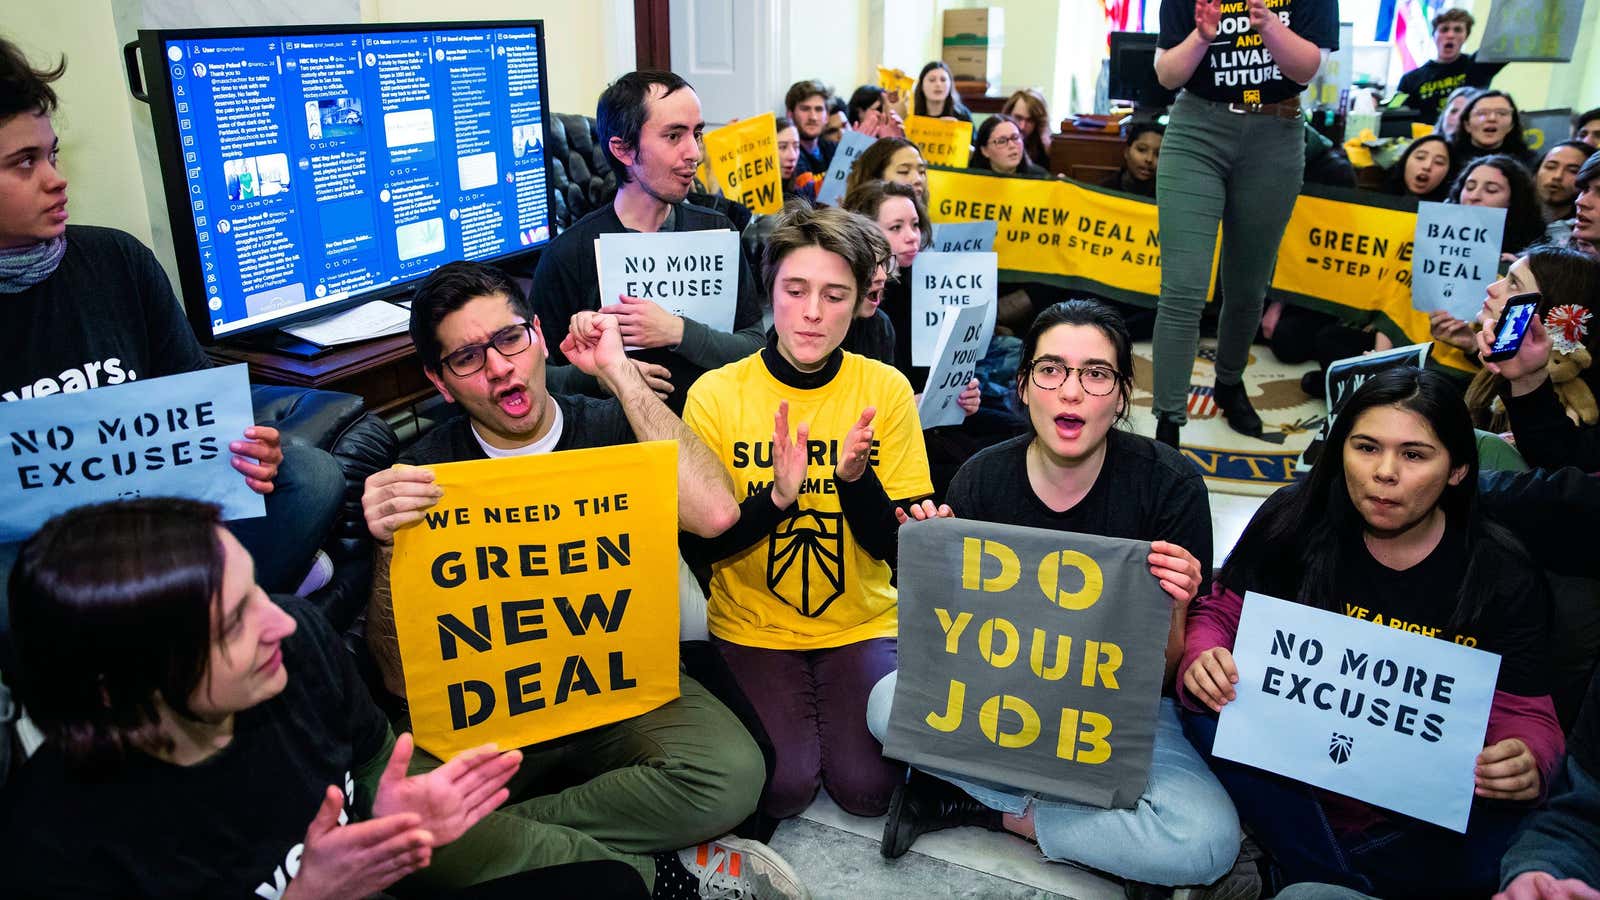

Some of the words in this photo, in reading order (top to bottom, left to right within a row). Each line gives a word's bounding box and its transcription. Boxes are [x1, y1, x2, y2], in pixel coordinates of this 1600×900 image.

[1216, 16, 1250, 36] OD
[1236, 34, 1262, 48] AND
[1220, 48, 1273, 68] LIVAB
[1214, 65, 1283, 86] FUTURE
[918, 142, 958, 155] REEN
[728, 156, 774, 188] GREEN
[737, 182, 776, 211] EW
[940, 199, 1013, 222] GREEN
[1022, 206, 1070, 226] NEW
[1078, 216, 1136, 243] DEAL
[1428, 224, 1488, 244] BACK
[942, 238, 984, 252] BACK
[1007, 230, 1031, 244] UP
[1038, 232, 1060, 248] OR
[1068, 235, 1114, 258] STEP
[1122, 250, 1161, 268] ASI
[1308, 228, 1389, 258] GREEN
[1439, 245, 1472, 258] THE
[625, 256, 656, 274] NO
[667, 254, 724, 272] MORE
[1423, 259, 1482, 281] DEAL
[626, 278, 722, 298] EXCUSES
[926, 274, 984, 290] BACK
[939, 295, 970, 306] THE
[940, 370, 974, 390] JOB
[10, 425, 75, 456] NO
[98, 401, 216, 444] MORE
[18, 436, 220, 490] EXCUSES
[733, 440, 881, 468] SURIE
[425, 508, 470, 530] WE
[484, 504, 561, 524] NEED
[574, 493, 629, 516] THE
[430, 533, 632, 588] GREEN
[961, 536, 1104, 611] DO
[436, 588, 632, 661] NEW
[1346, 603, 1370, 618] VE
[1389, 617, 1442, 639] RIGH
[934, 607, 1124, 690] YOUR
[1270, 629, 1324, 666] NO
[1340, 648, 1456, 705] MORE
[448, 651, 638, 731] DEAL
[1261, 666, 1446, 744] EXCUSES
[925, 679, 1113, 765] JOB
